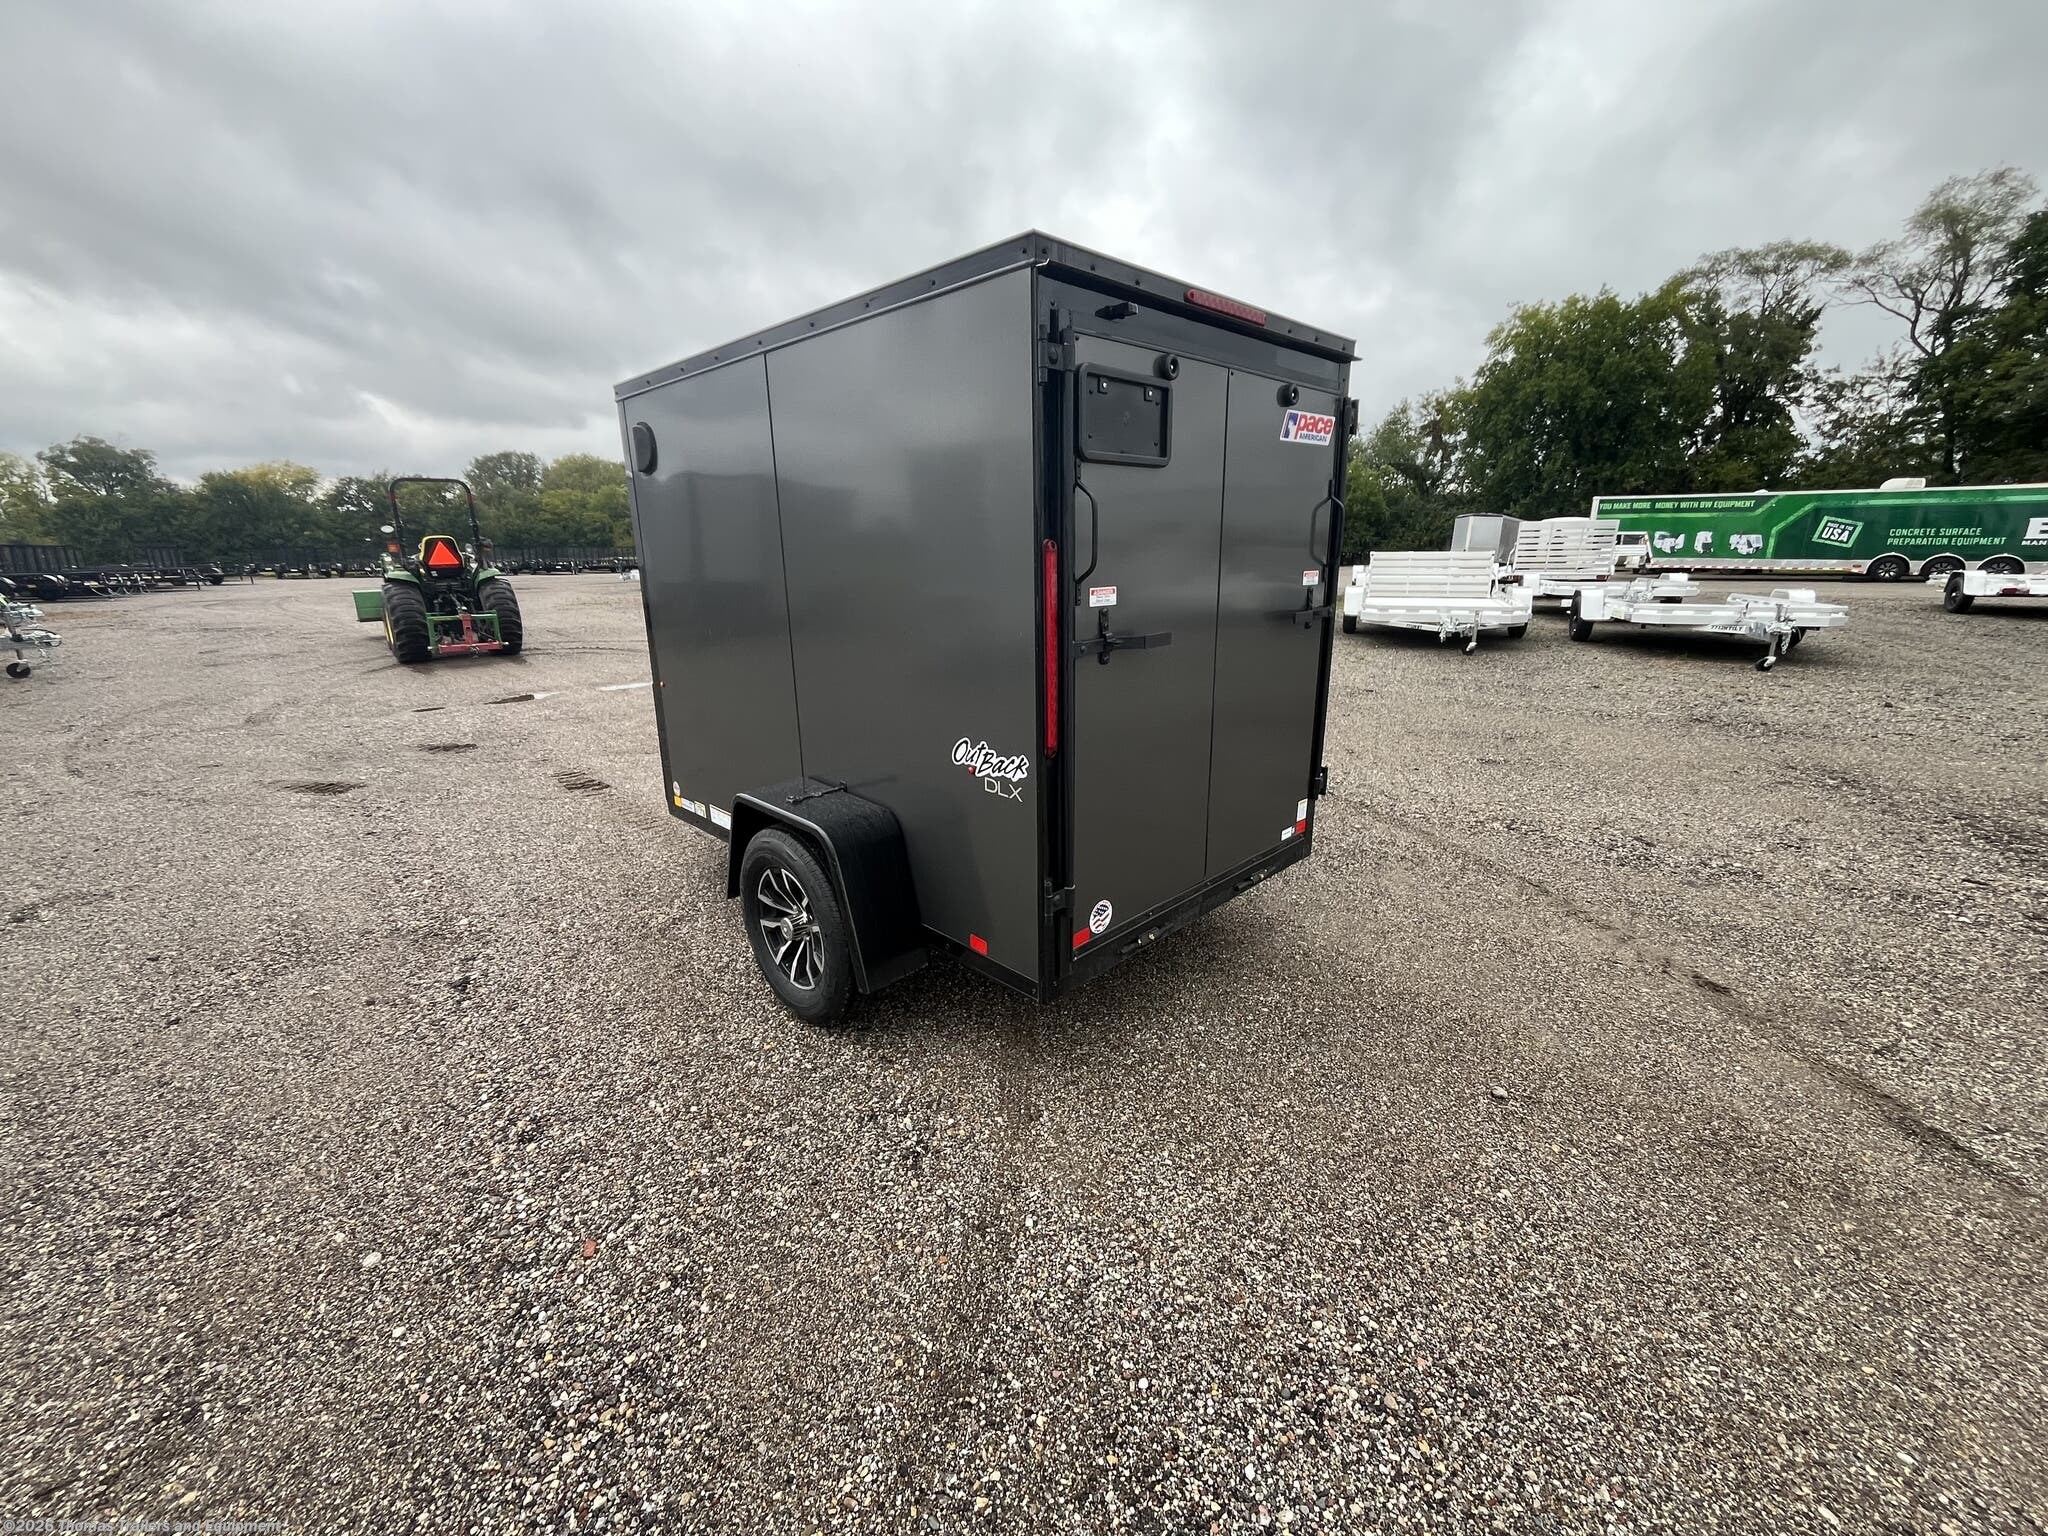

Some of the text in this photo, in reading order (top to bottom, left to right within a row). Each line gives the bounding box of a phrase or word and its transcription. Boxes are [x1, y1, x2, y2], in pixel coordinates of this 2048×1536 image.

[1294, 414, 1333, 440] pace
[1299, 432, 1328, 442] AMERICAN
[1613, 502, 1631, 510] MAKE
[1655, 501, 1679, 509] MONEY
[1714, 500, 1756, 508] EQUIPMENT
[1821, 526, 1850, 542] USA
[1889, 527, 1982, 537] CONCRETE SURFACE
[1886, 537, 2007, 546] PREPARATION EQUIPMENT
[984, 777, 1023, 803] DLX
